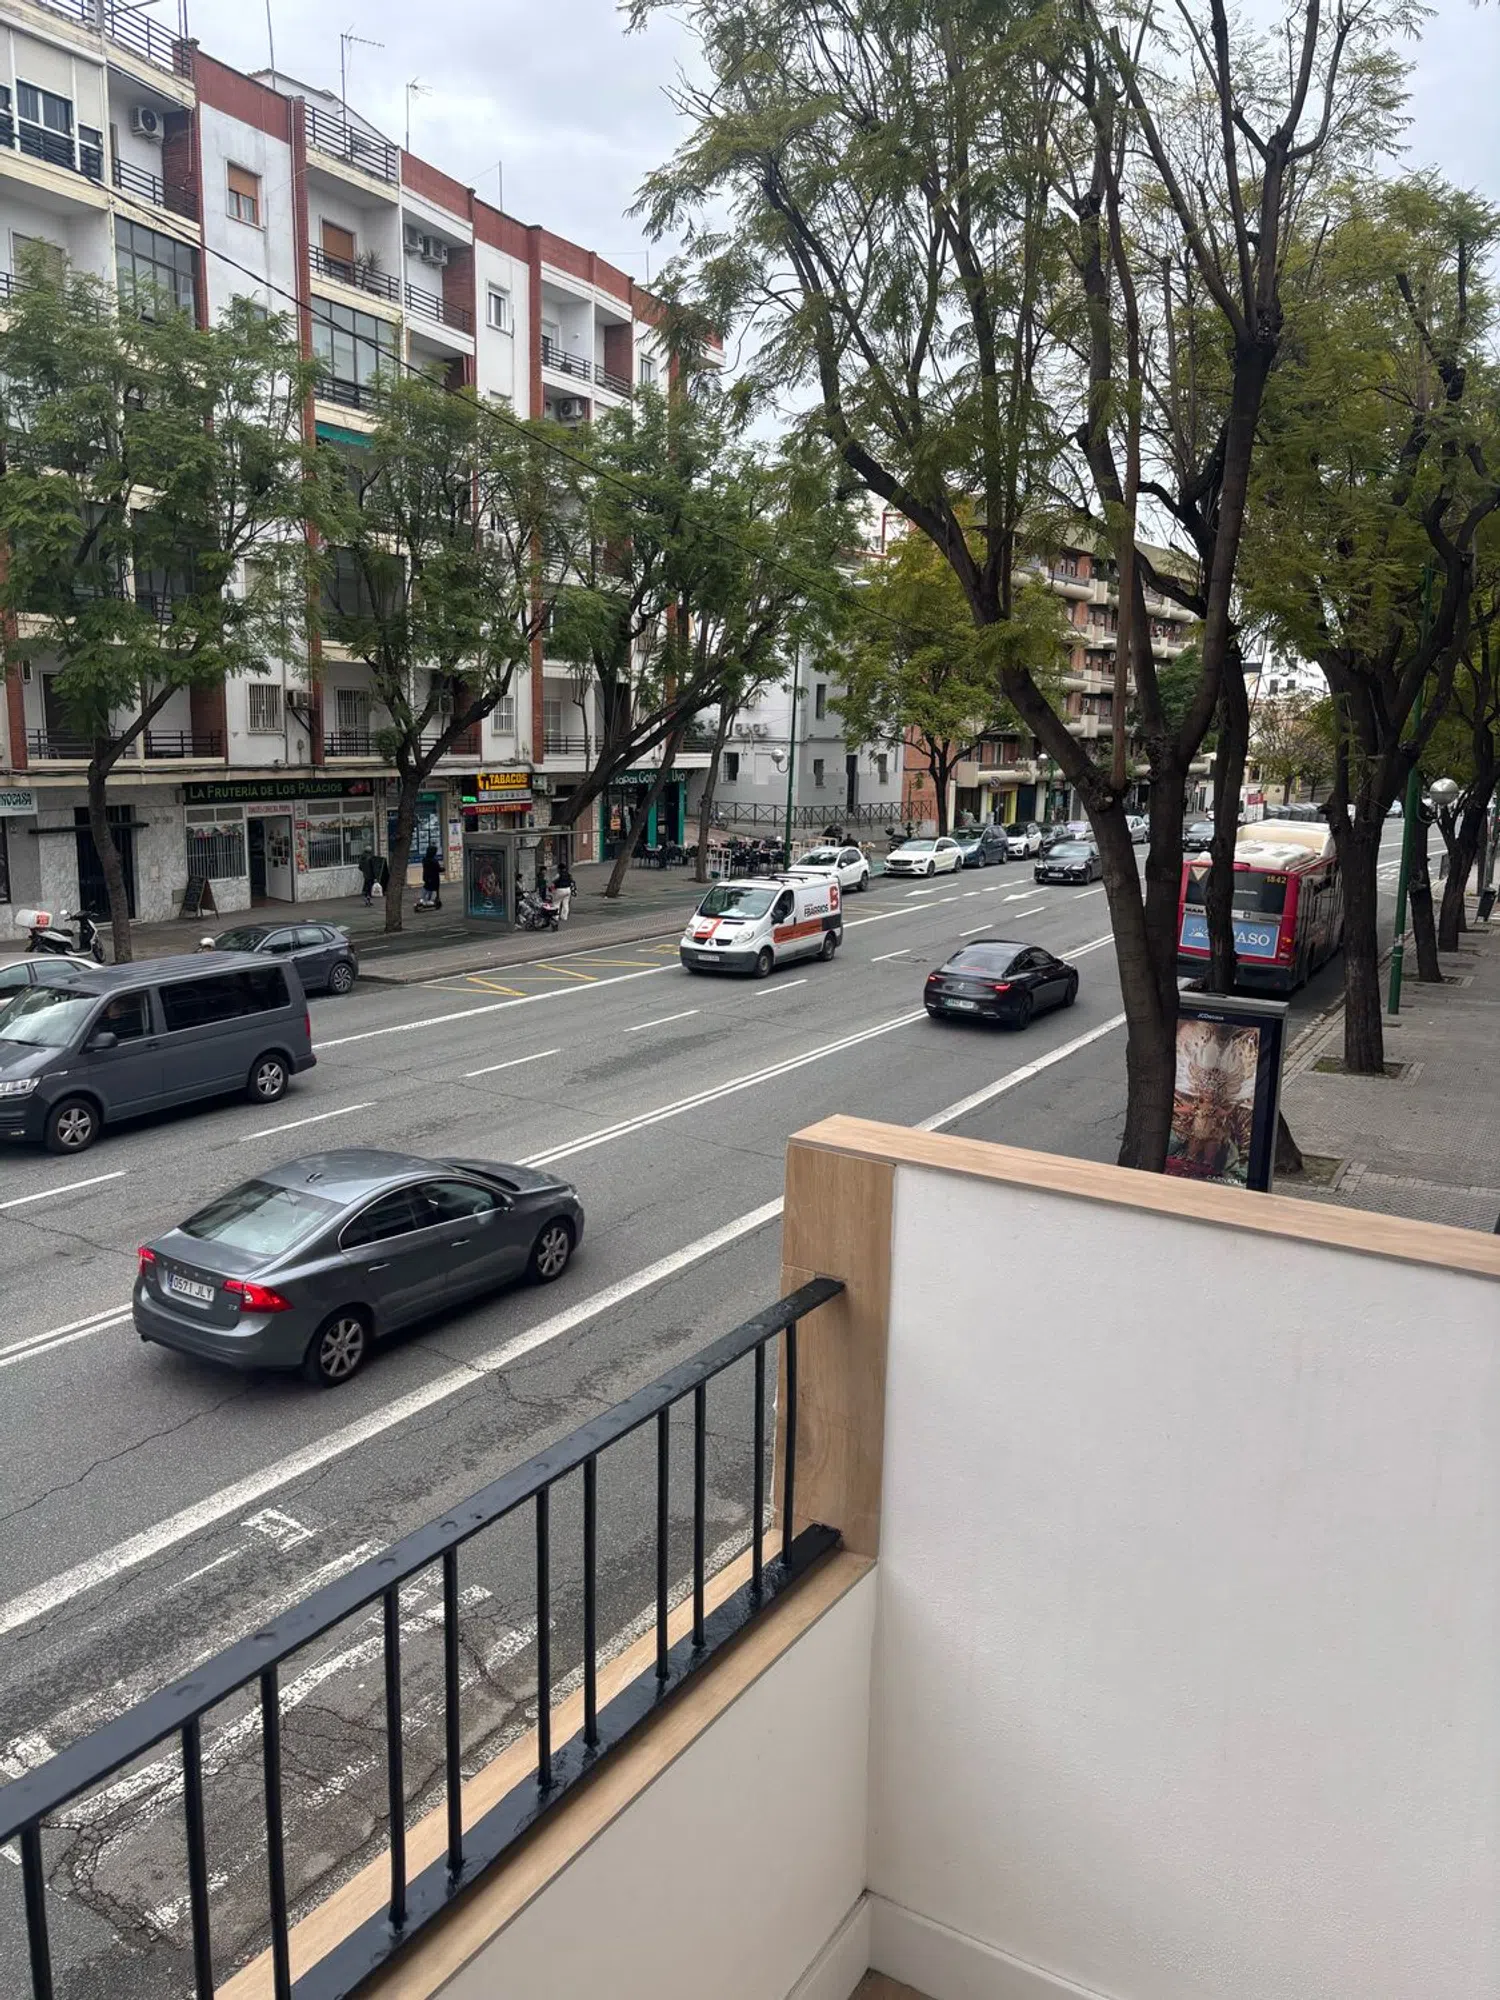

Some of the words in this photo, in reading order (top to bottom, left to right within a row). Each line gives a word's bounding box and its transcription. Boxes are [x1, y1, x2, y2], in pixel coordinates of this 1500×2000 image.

[489, 773, 528, 785] TABACOS
[189, 785, 205, 799] LA
[260, 785, 274, 796] DE
[276, 783, 296, 795] LOS
[299, 781, 343, 794] PALACIOS
[1266, 874, 1287, 884] 1842
[173, 1277, 192, 1294] 0571
[195, 1285, 212, 1299] JLY
